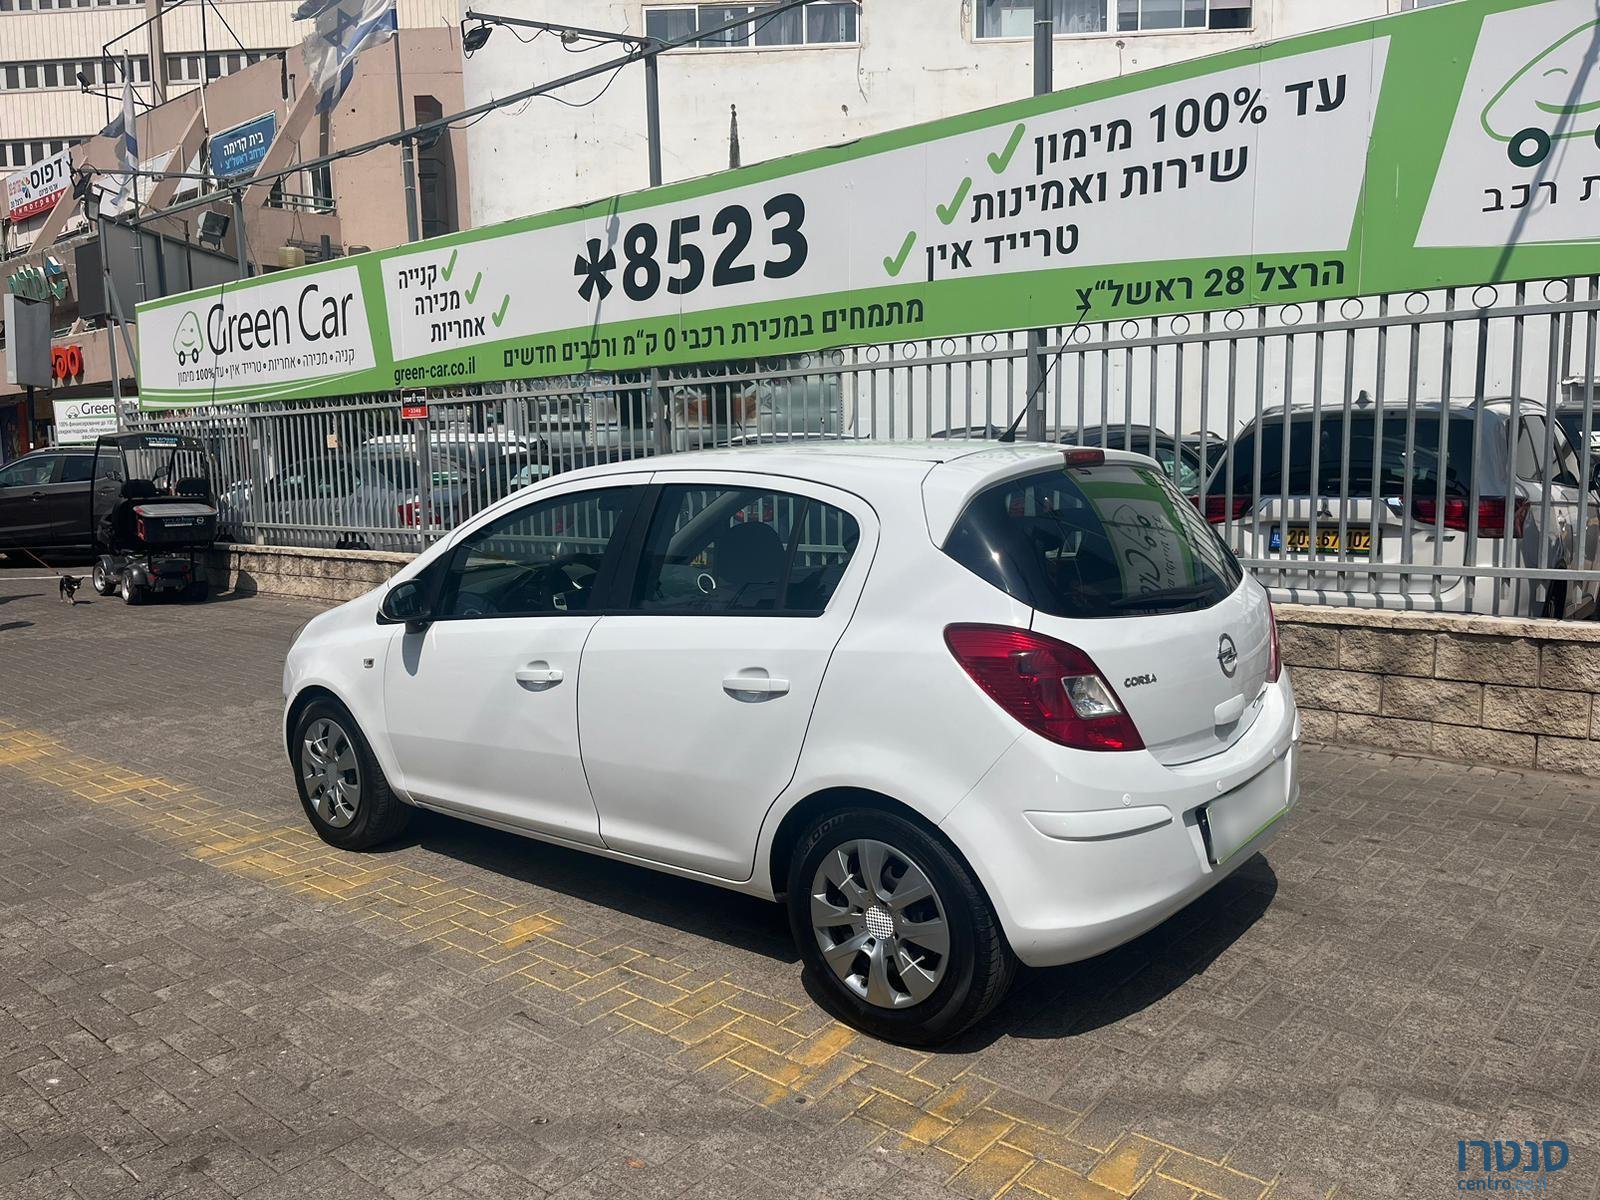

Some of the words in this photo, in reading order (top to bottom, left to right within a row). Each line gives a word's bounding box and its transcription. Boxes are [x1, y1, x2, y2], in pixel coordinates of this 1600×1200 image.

[1284, 74, 1347, 116] עד
[1149, 86, 1268, 143] 100%
[249, 132, 264, 147] בית
[1033, 118, 1132, 176] מימון
[30, 158, 63, 189] דפוס
[1120, 145, 1249, 196] שירות
[970, 172, 1107, 223] ואמינות
[1482, 181, 1557, 213] רכב
[984, 223, 1080, 265] טרייד
[925, 239, 973, 282] אין
[398, 264, 438, 290] קנייה
[1204, 265, 1244, 298] 28
[1256, 259, 1345, 292] הרצל
[415, 290, 460, 316] מכירה
[822, 297, 924, 334] מתמחים
[207, 303, 290, 355] Green
[298, 284, 353, 341] Car
[431, 316, 485, 343] אחריות
[731, 311, 814, 346] במכירת
[562, 336, 617, 361] ורכבים
[664, 327, 676, 351] 0
[680, 325, 724, 352] רכבי
[241, 360, 262, 374] טרייד
[268, 356, 296, 371] אחריות
[302, 352, 328, 367] מכירה
[335, 349, 355, 365] קניה
[503, 344, 557, 367] חדשים
[177, 370, 195, 387] מימון
[195, 367, 215, 381] 100%
[229, 363, 240, 379] אין
[394, 356, 476, 386] green-car.co.il
[81, 402, 117, 415] Green
[1123, 673, 1158, 689] CORSA
